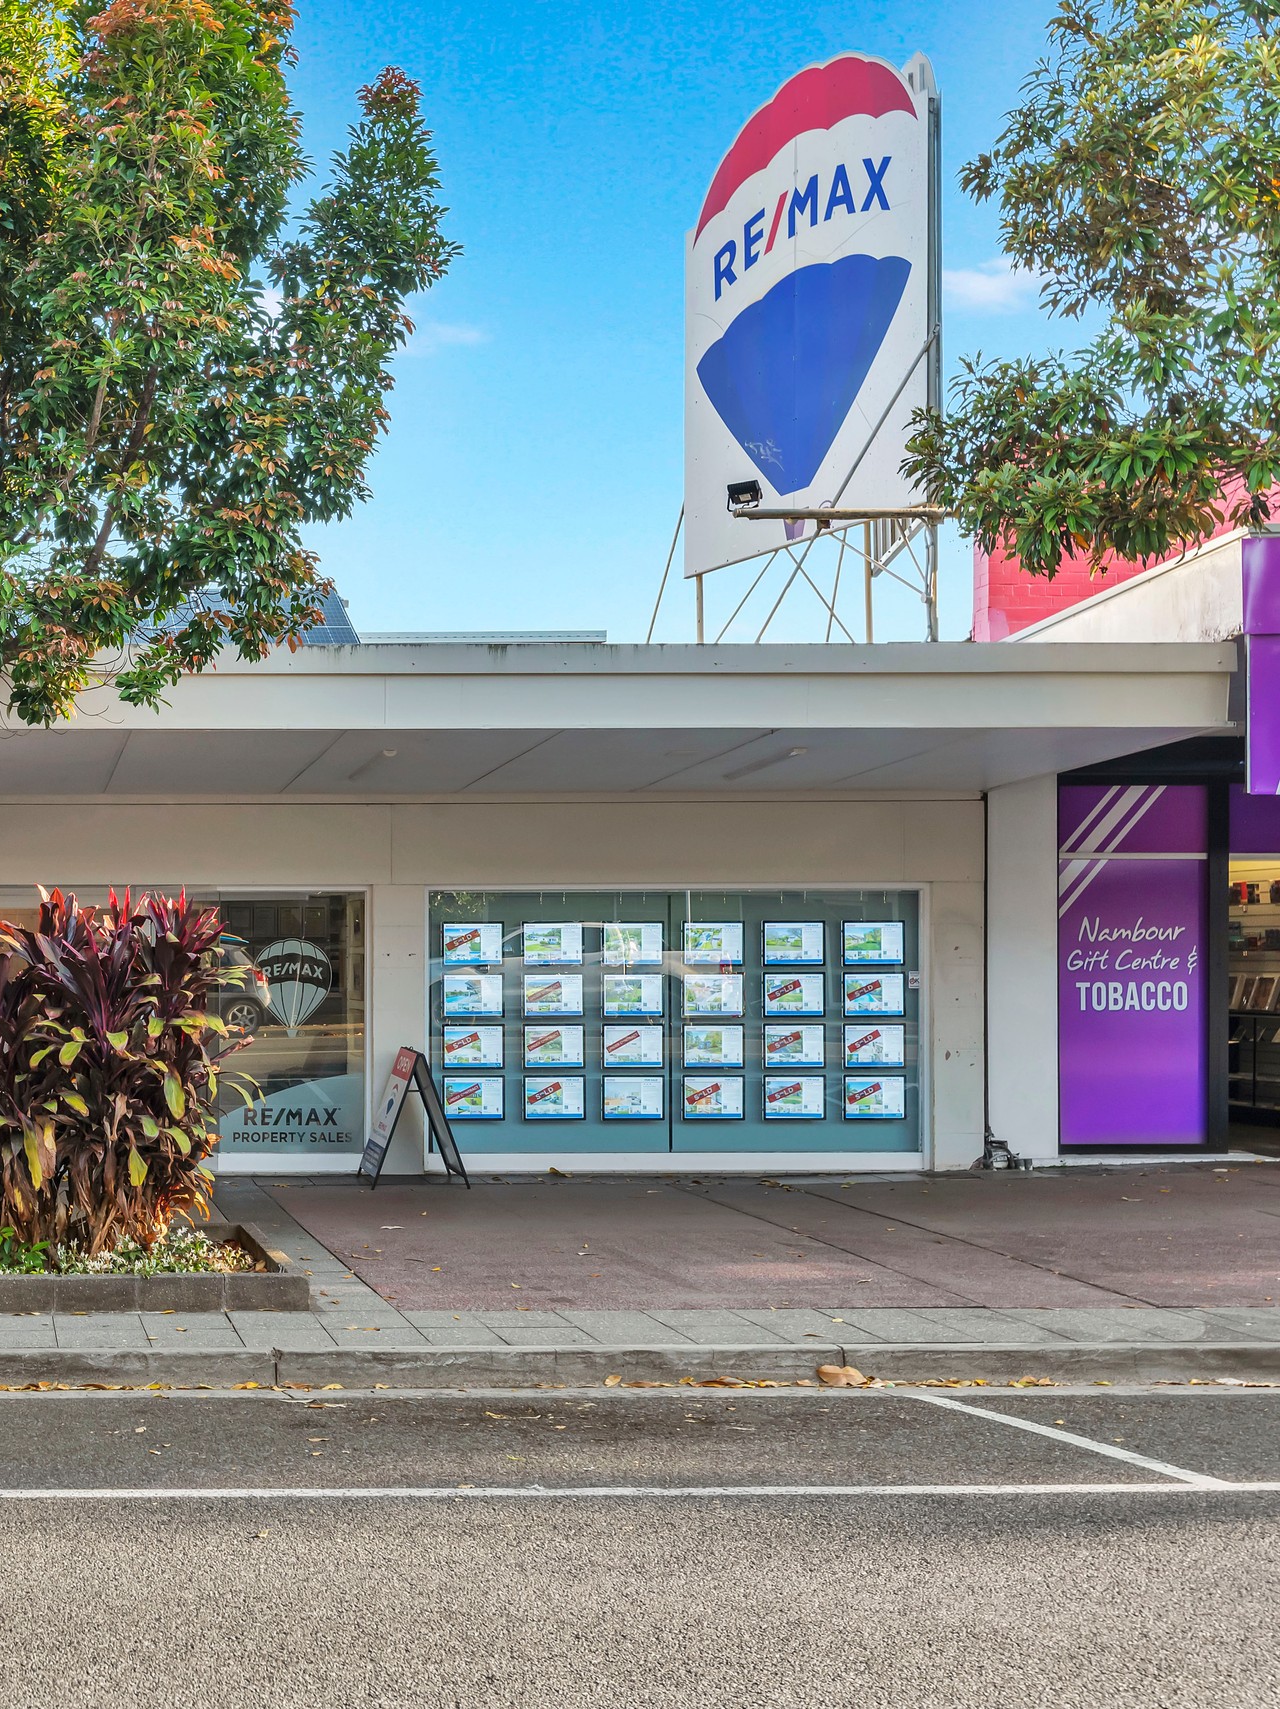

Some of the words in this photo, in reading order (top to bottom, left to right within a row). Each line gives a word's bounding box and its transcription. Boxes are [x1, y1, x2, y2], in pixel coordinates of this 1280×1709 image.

[713, 156, 892, 302] RE/MAX
[1078, 916, 1186, 942] Nambour
[262, 962, 323, 980] RE/MAX
[1067, 949, 1109, 972] Gift
[1114, 949, 1180, 971] Centre
[1187, 945, 1198, 975] &
[1075, 981, 1188, 1011] TOBACCO
[243, 1107, 338, 1126] RE/MAX
[232, 1131, 306, 1143] PROPERTY
[309, 1131, 353, 1143] SALES
